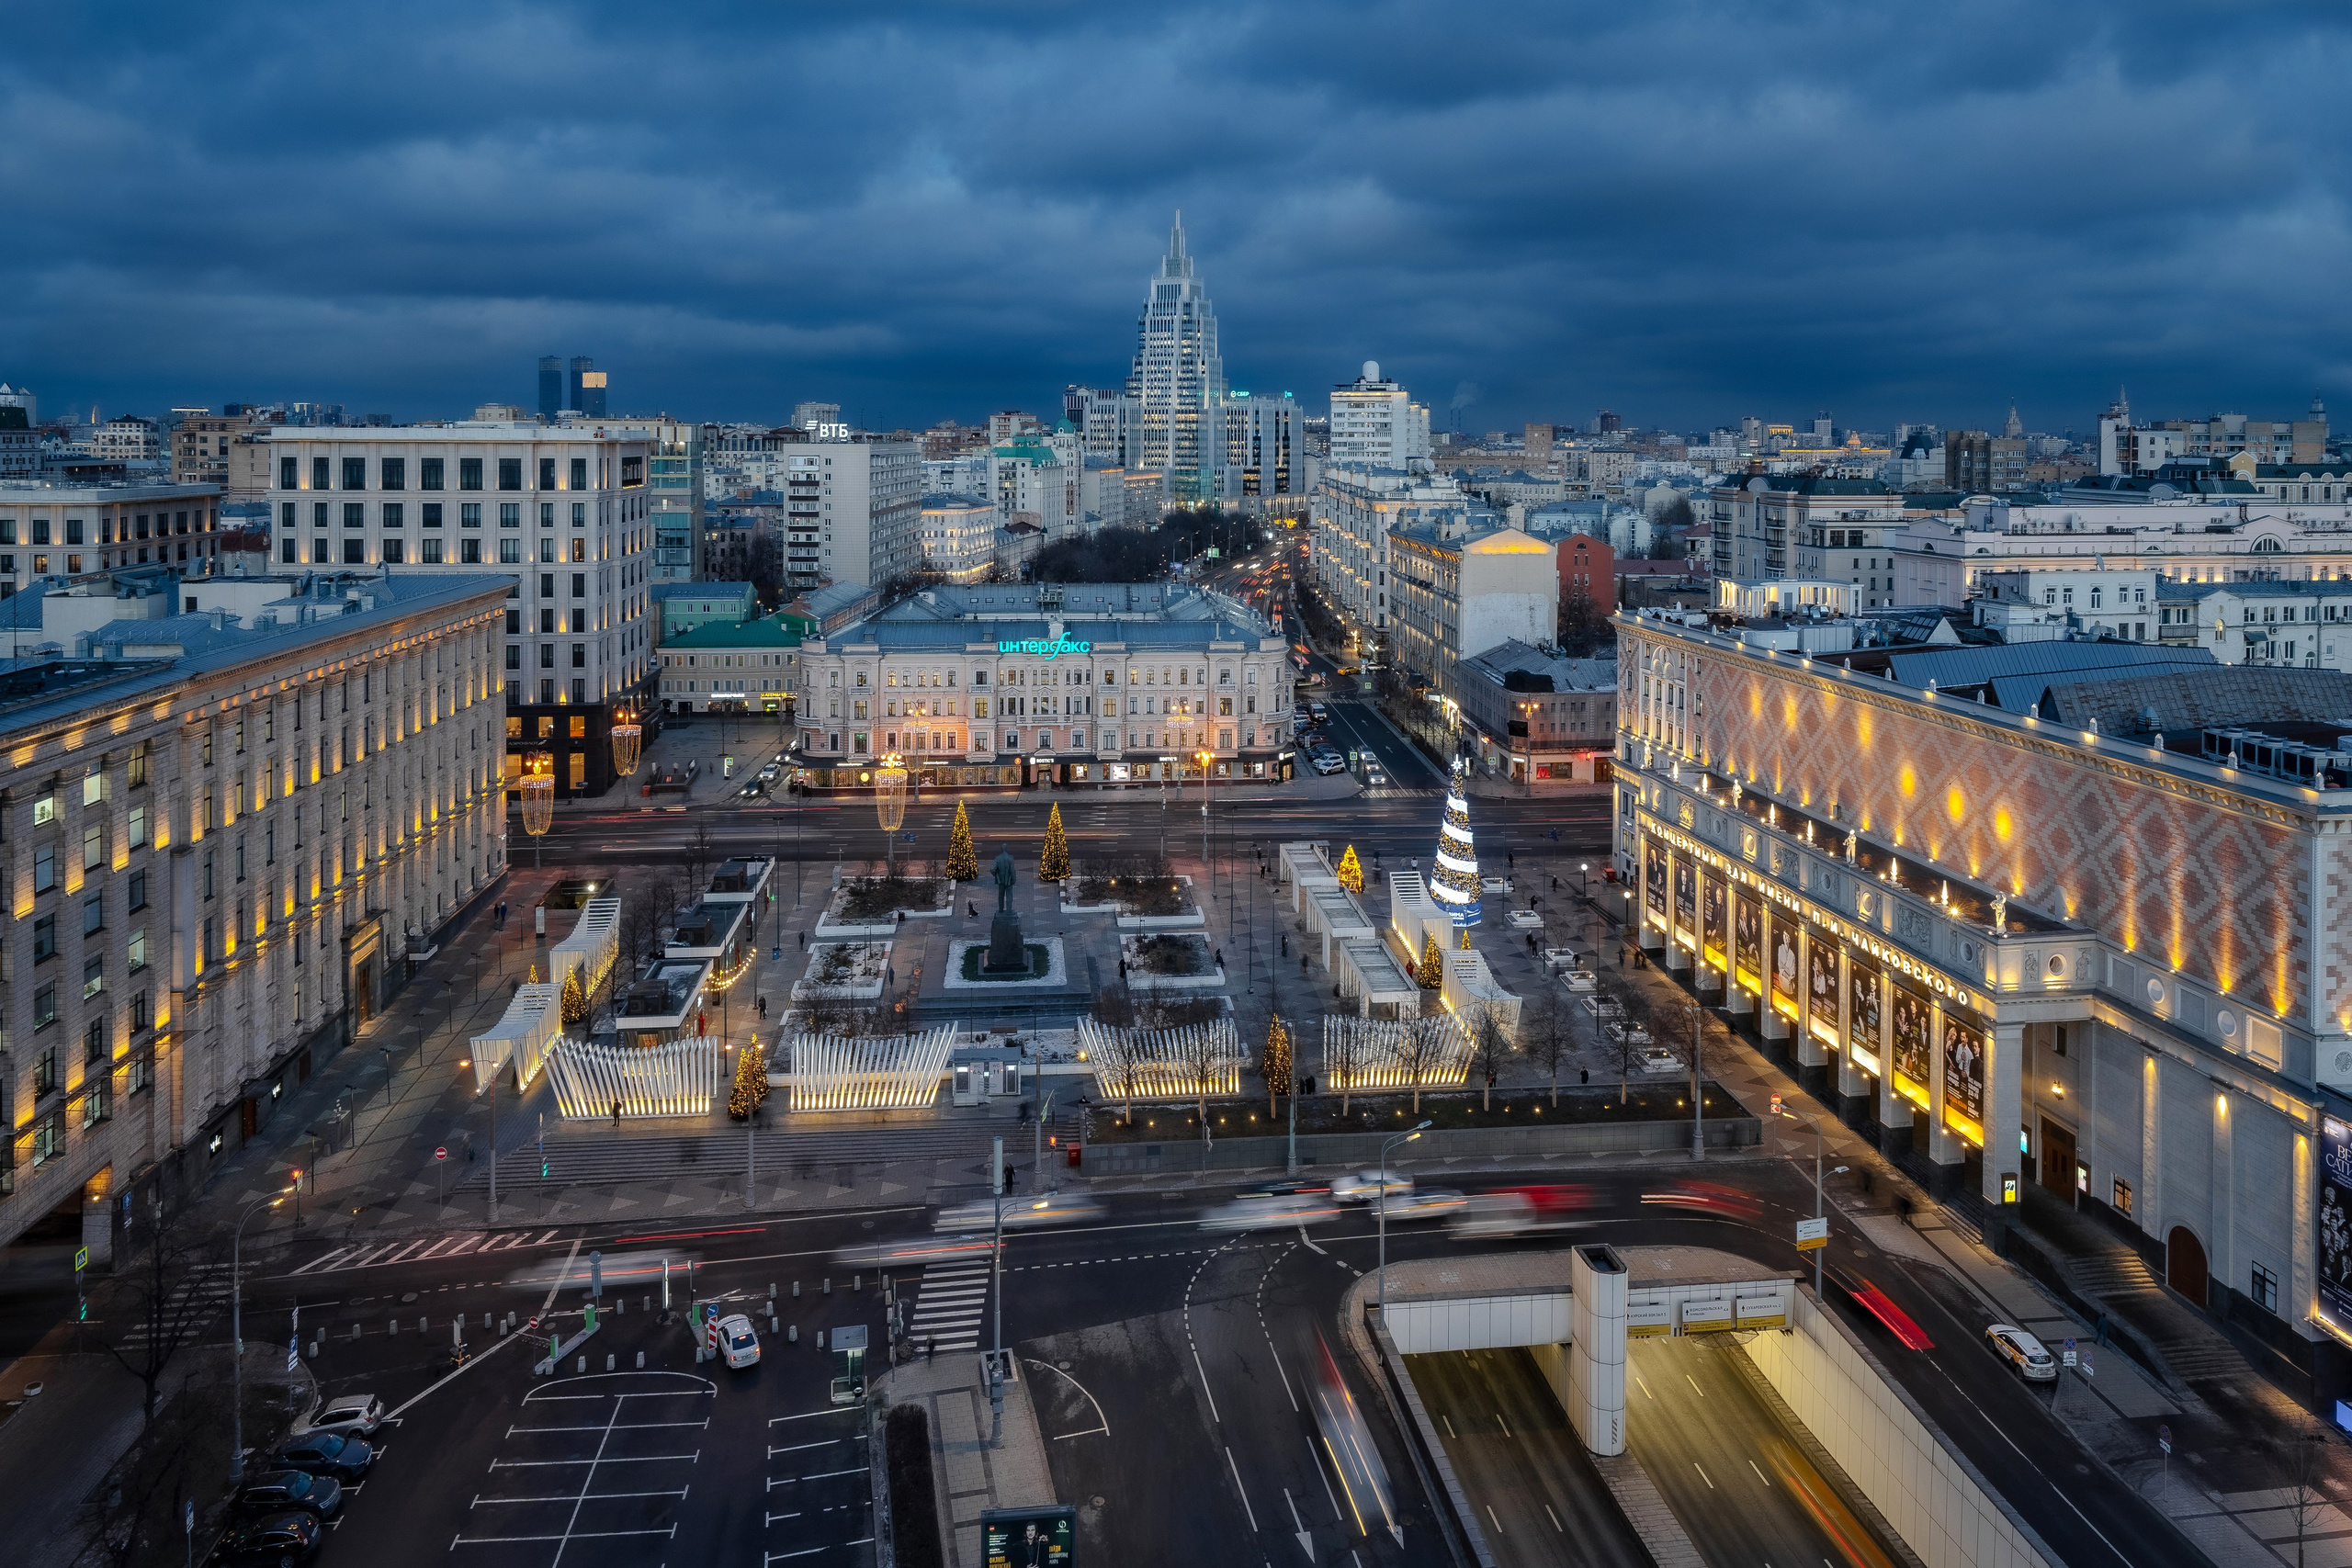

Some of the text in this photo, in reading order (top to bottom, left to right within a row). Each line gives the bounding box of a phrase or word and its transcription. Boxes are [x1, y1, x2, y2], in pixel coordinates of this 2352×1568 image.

[820, 423, 849, 438] ВТБ
[999, 631, 1091, 660] интерфакс
[1650, 821, 1717, 866] КОНЦЕРТНЫЙ
[1726, 863, 1747, 885] ЗАЛ
[1758, 880, 1800, 913] ИМЕНИ
[1851, 931, 1969, 1006] ЧАЙКОВСКОГО
